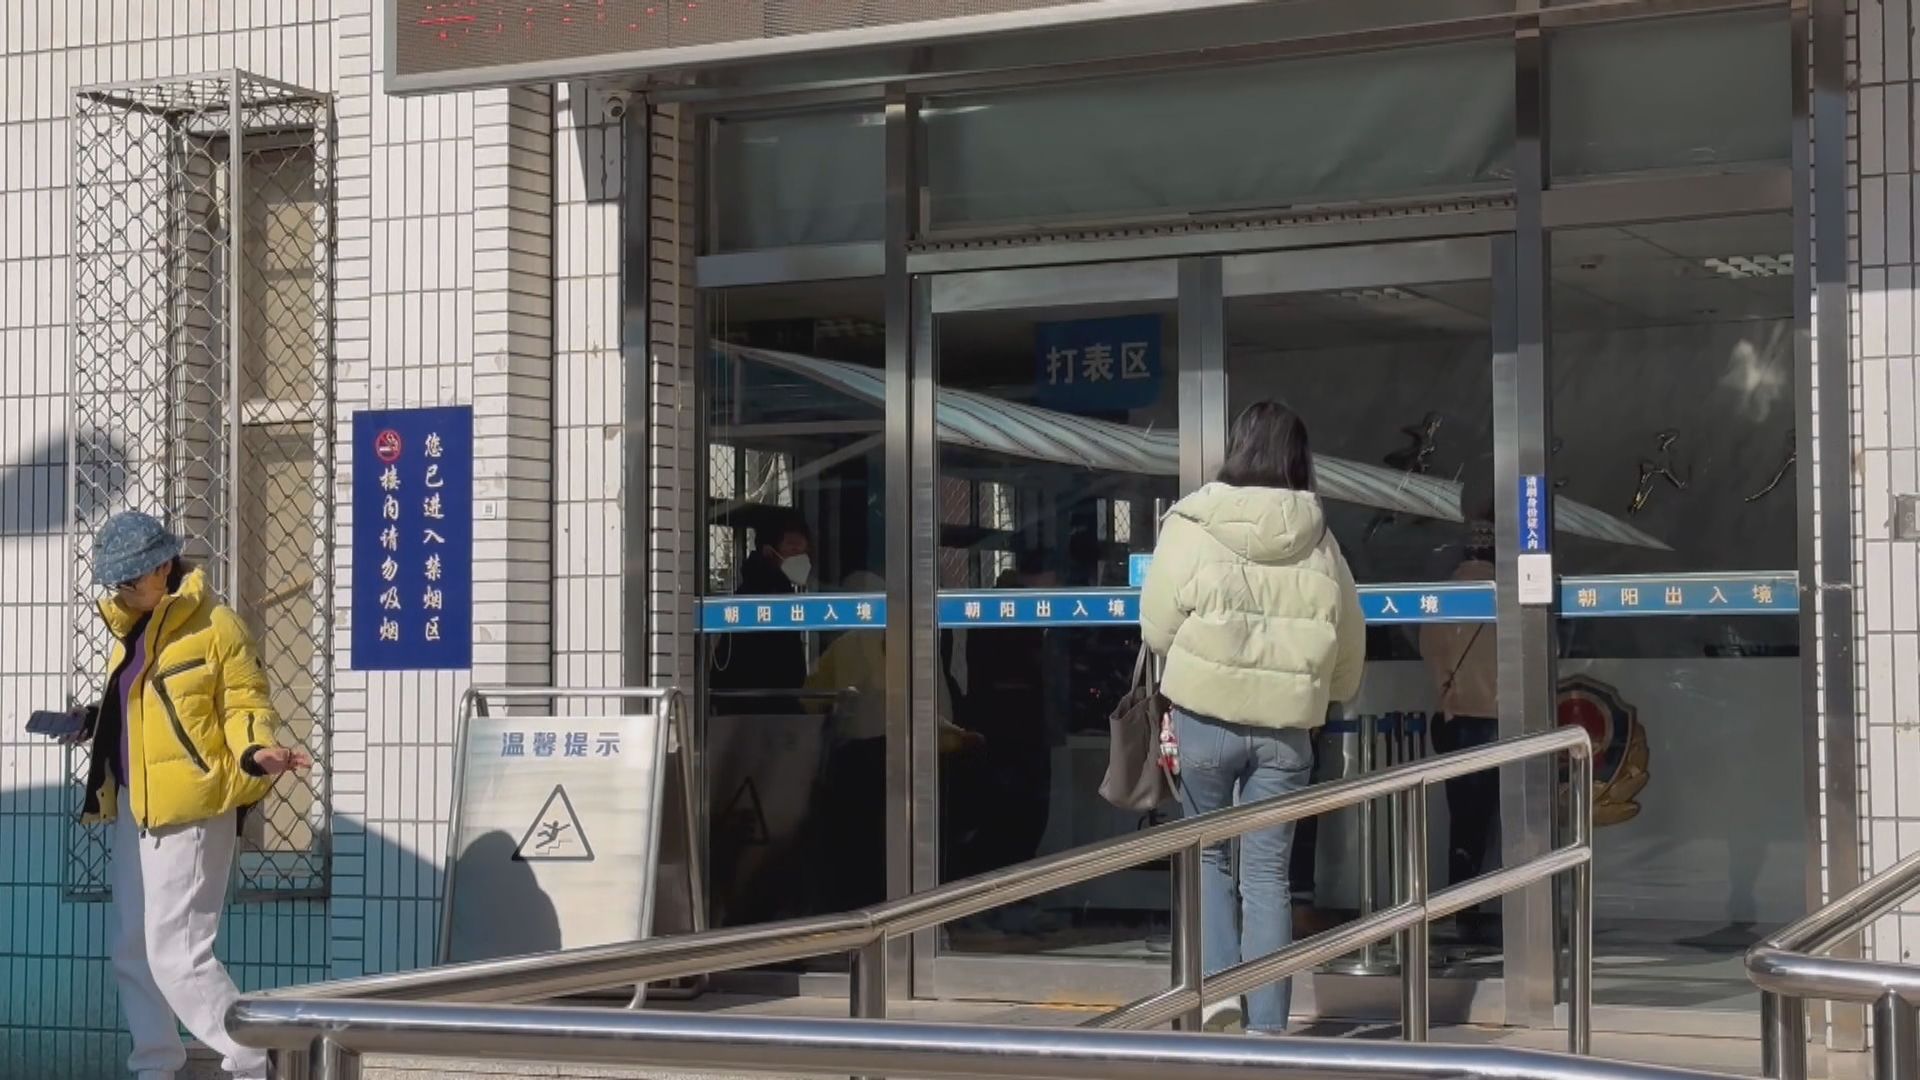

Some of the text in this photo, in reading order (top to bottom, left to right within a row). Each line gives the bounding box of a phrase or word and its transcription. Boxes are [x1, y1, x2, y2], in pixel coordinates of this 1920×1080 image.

[1046, 342, 1151, 385] 打表区
[423, 432, 446, 641] 您已进入禁烟区
[379, 463, 402, 642] 楼内请勿吸烟
[964, 598, 1125, 619] 朝阳出入境
[1578, 584, 1773, 608] 朝阳出入境
[723, 601, 873, 624] 朝阳出入境
[500, 731, 621, 758] 温馨提示
